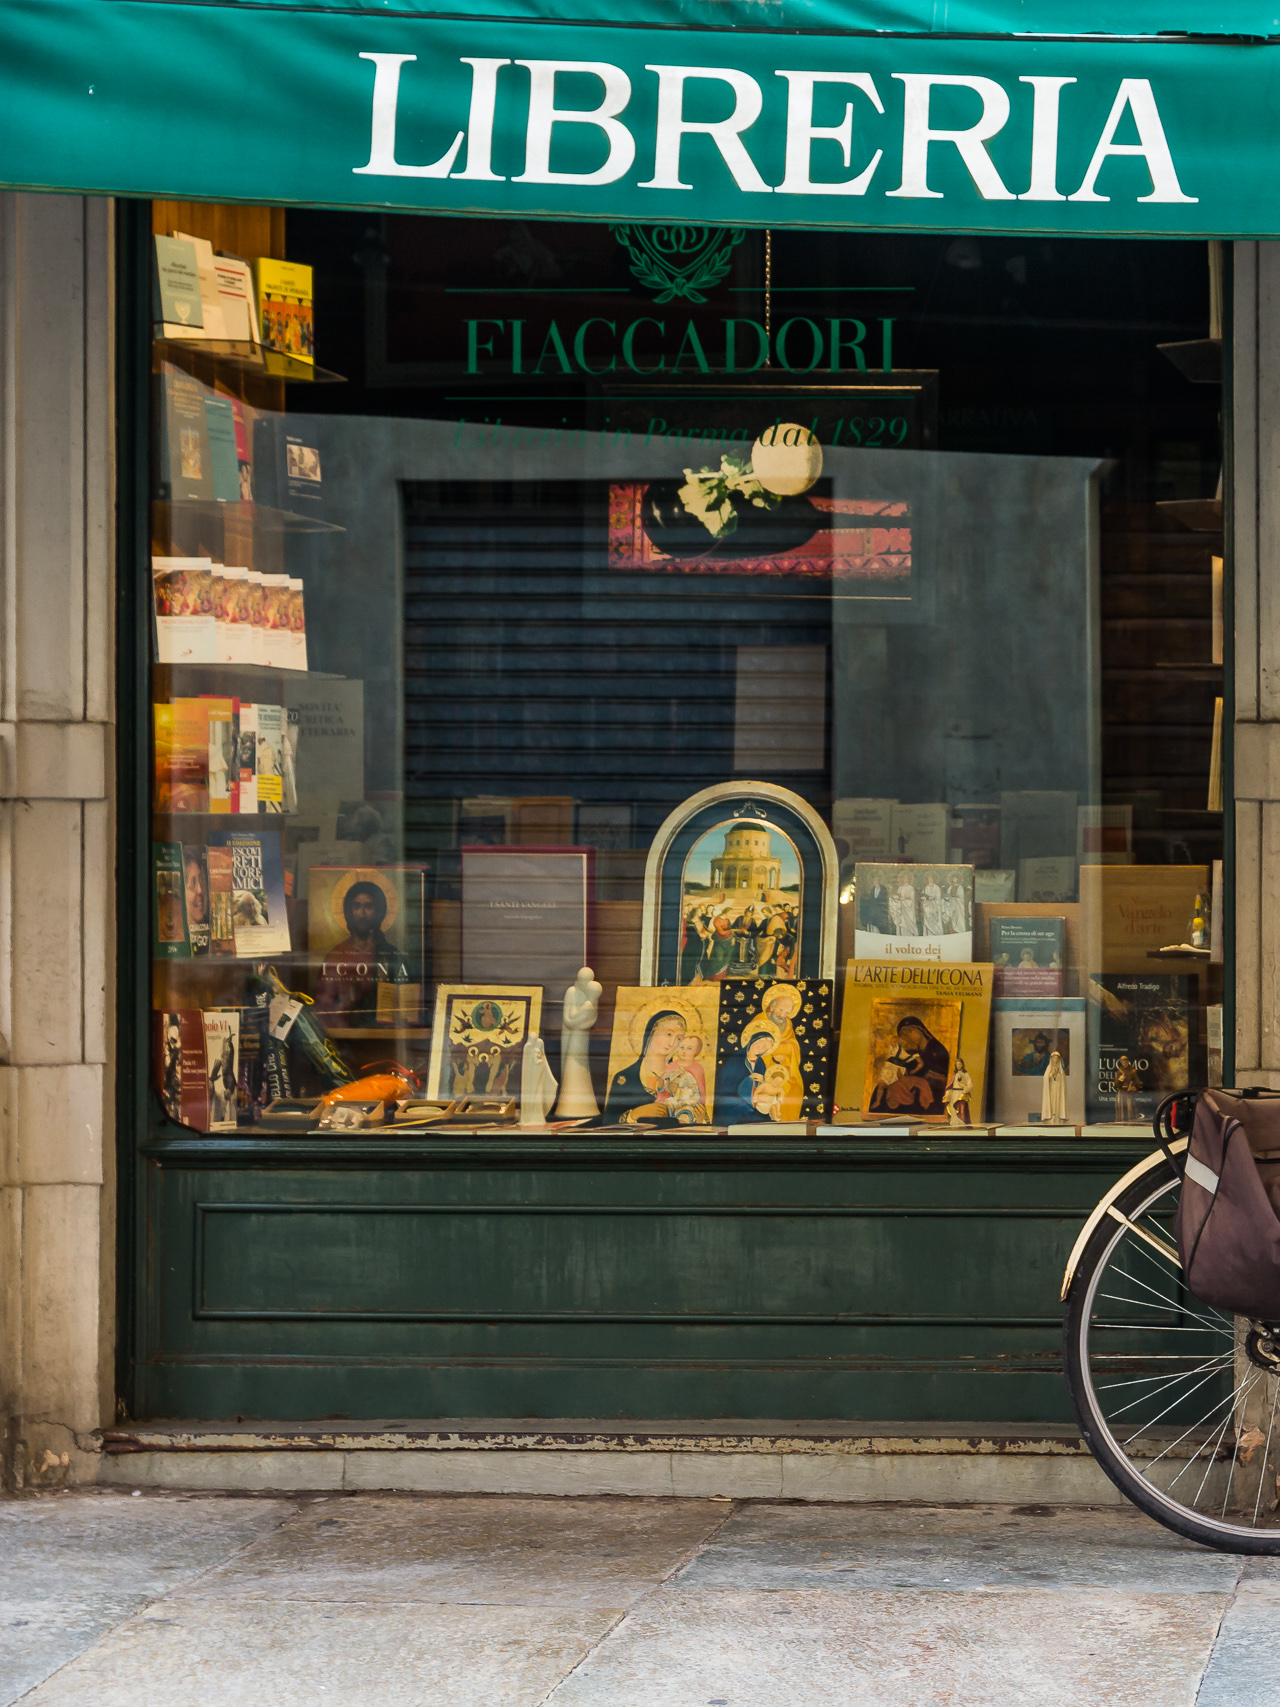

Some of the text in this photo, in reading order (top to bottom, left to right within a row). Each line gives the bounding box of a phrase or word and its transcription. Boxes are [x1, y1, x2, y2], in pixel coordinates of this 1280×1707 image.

[352, 51, 1199, 203] LIBRERIA
[462, 316, 897, 375] FIACCADORI
[452, 416, 909, 448] Libreria in Parma dal 1829
[232, 847, 262, 856] ESCOVI
[232, 855, 262, 868] RETI
[232, 867, 263, 878] UORE
[1118, 904, 1172, 920] Vangelo
[885, 943, 942, 954] il volto dei
[321, 962, 409, 976] ICONA
[854, 965, 898, 983] L'ARTE
[901, 967, 983, 986] DELL'ICONA
[1117, 982, 1160, 991] Alfredo Tradigo
